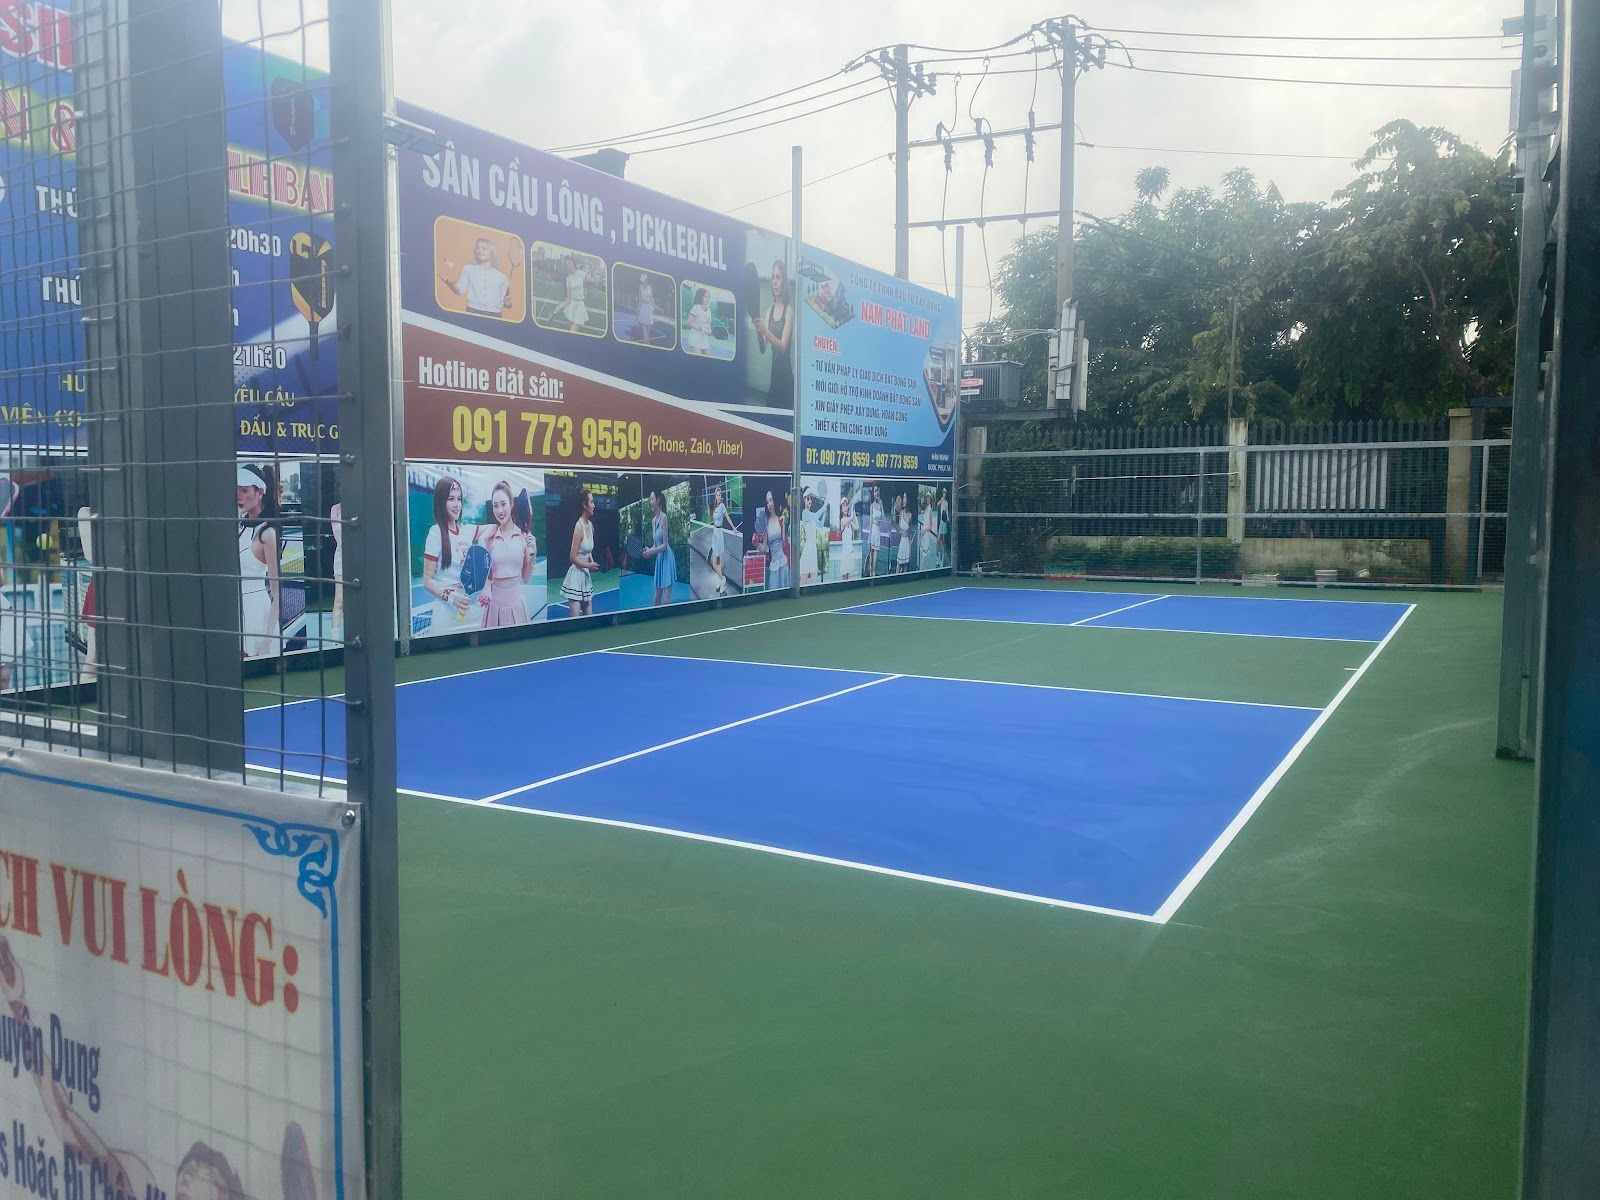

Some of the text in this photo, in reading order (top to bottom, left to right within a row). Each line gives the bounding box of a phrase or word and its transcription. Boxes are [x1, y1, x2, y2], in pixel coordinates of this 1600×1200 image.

[422, 140, 480, 200] SÂN
[488, 157, 538, 216] CẦU
[546, 179, 604, 236] LÔNG
[622, 206, 727, 271] PICKLEBALL
[861, 300, 882, 326] NAM
[909, 315, 930, 339] LAND
[418, 356, 564, 401] Hotline đặt sân:
[240, 414, 341, 443] ĐẤU & TRỤC G
[452, 405, 744, 460] 091 773 9559 (Phone, Zalo, Viber)
[820, 449, 835, 466] 090
[837, 450, 851, 467] 773
[852, 451, 870, 468] 9559
[875, 453, 888, 468] 097
[890, 454, 901, 469] 773
[902, 455, 919, 470] 9559
[49, 863, 128, 965] VUI
[139, 868, 299, 1013] LÒNG:
[0, 1005, 100, 1113] uyên Dụng
[90, 1156, 137, 1200] Ch
